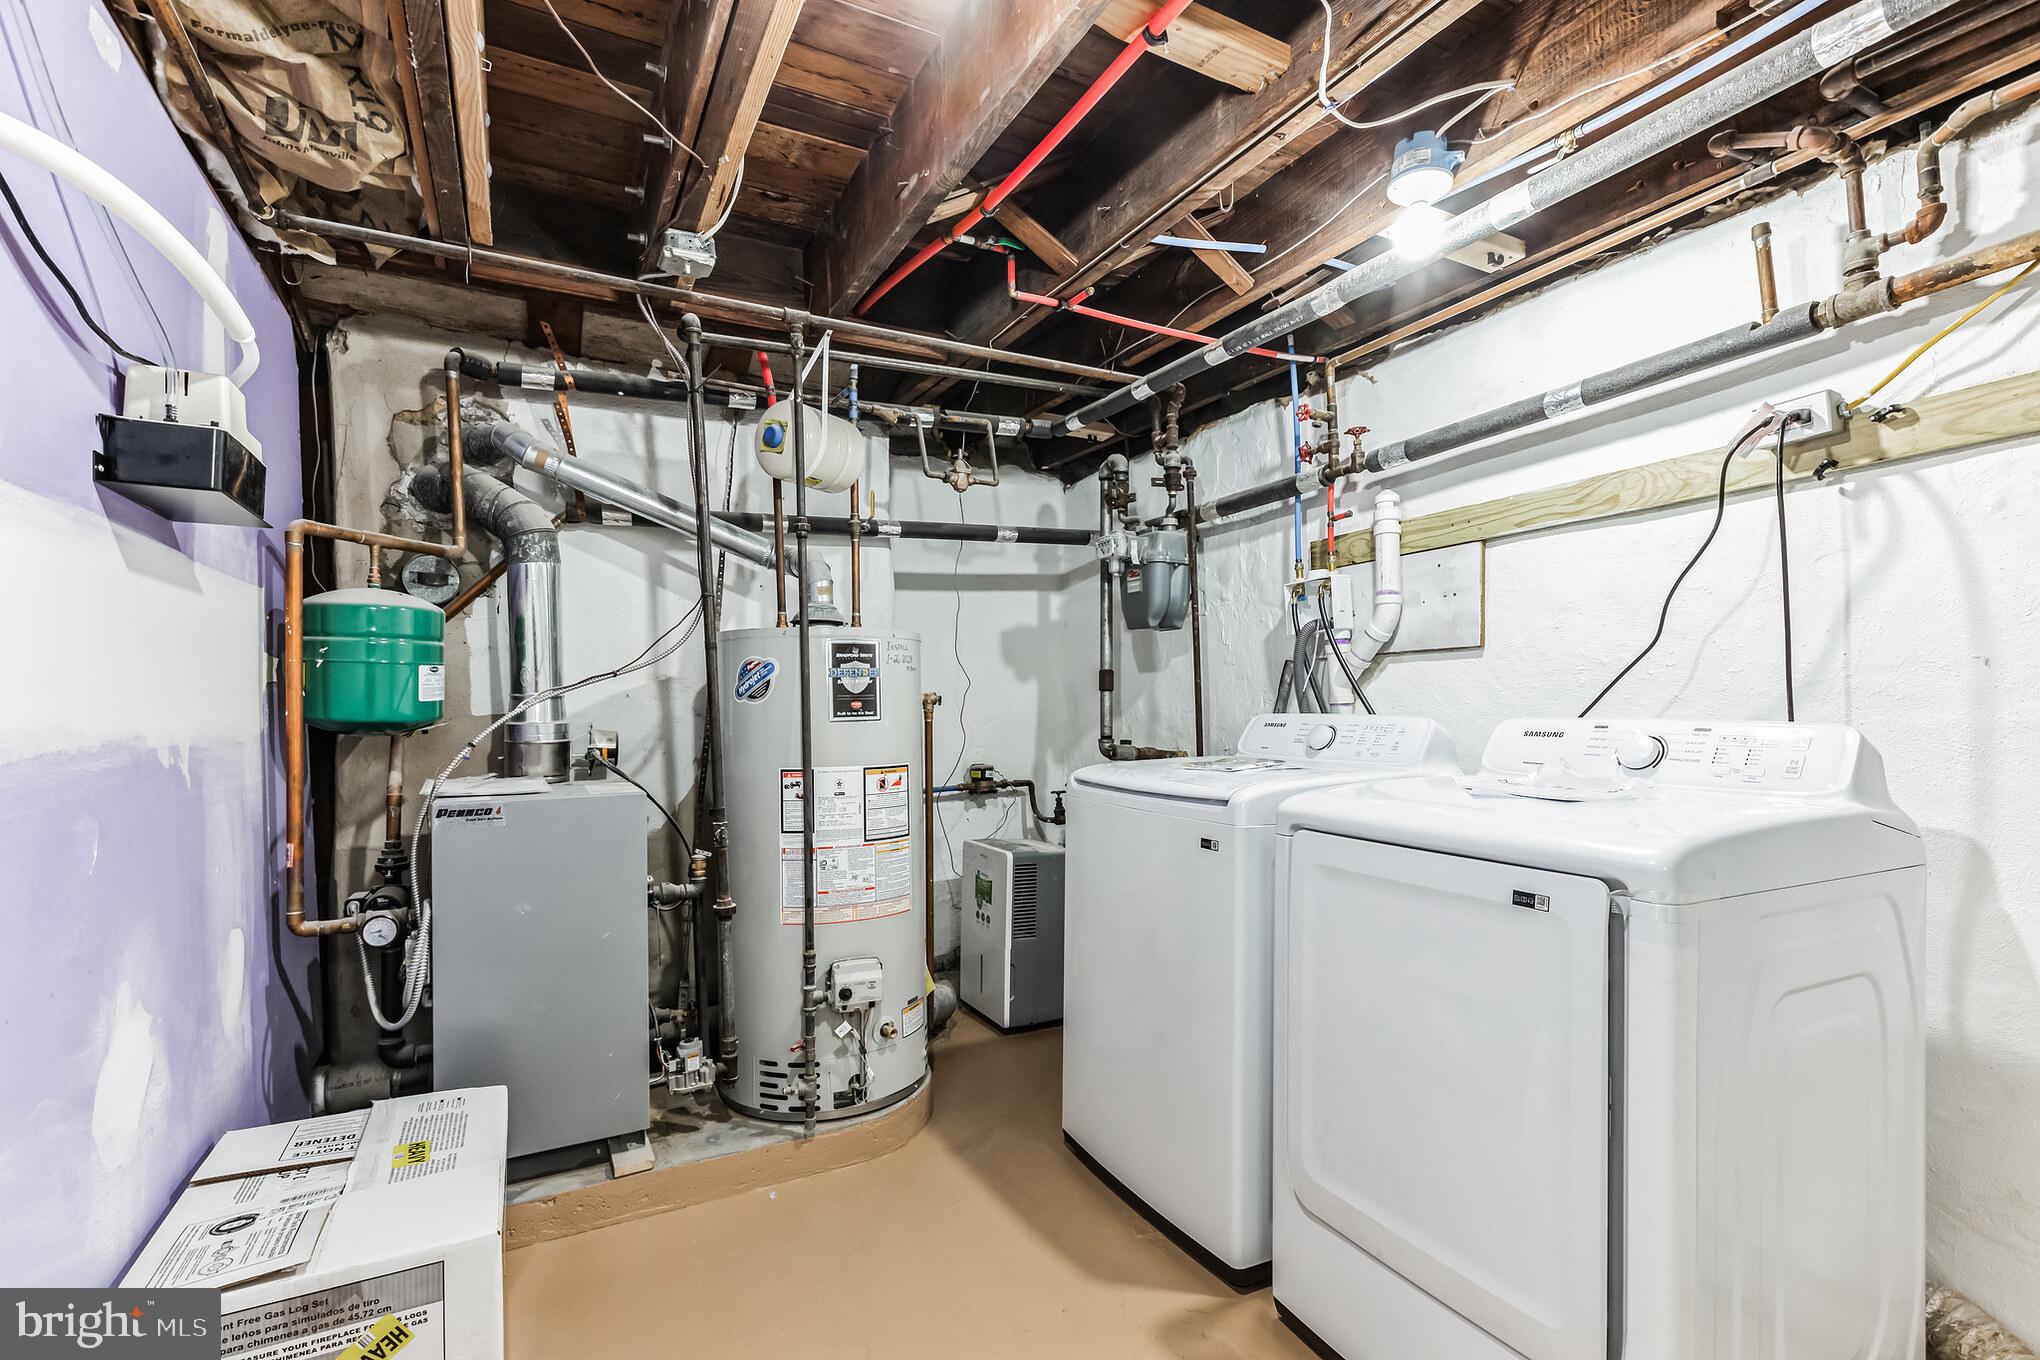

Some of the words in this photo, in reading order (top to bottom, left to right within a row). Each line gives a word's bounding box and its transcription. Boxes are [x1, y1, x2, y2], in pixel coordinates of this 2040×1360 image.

[1523, 730, 1565, 739] SAMSUNG
[435, 807, 493, 819] PENNCO
[293, 1133, 357, 1147] DETENER
[293, 1145, 345, 1158] NOTICE
[407, 1141, 426, 1164] HEAVY
[221, 1321, 234, 1331] nt
[237, 1315, 261, 1329] Free
[264, 1308, 286, 1320] Gas
[288, 1302, 309, 1315] Log
[311, 1298, 330, 1309] Set
[231, 1327, 262, 1342] leños
[264, 1321, 289, 1335] para
[291, 1306, 346, 1326] simulados
[347, 1301, 361, 1312] de
[362, 1297, 381, 1308] tiro
[247, 1330, 299, 1349] chimenea
[301, 1326, 309, 1334] a
[311, 1321, 331, 1335] gas
[332, 1316, 346, 1327] de
[377, 1304, 393, 1314] cm
[241, 1349, 279, 1360] ASURE
[282, 1341, 308, 1353] YOUR
[311, 1326, 362, 1347] FIREPLACE
[404, 1309, 429, 1321] LOGS
[272, 1347, 318, 1360] HIMENEA
[320, 1339, 345, 1350] PARA
[411, 1317, 429, 1328] GAS
